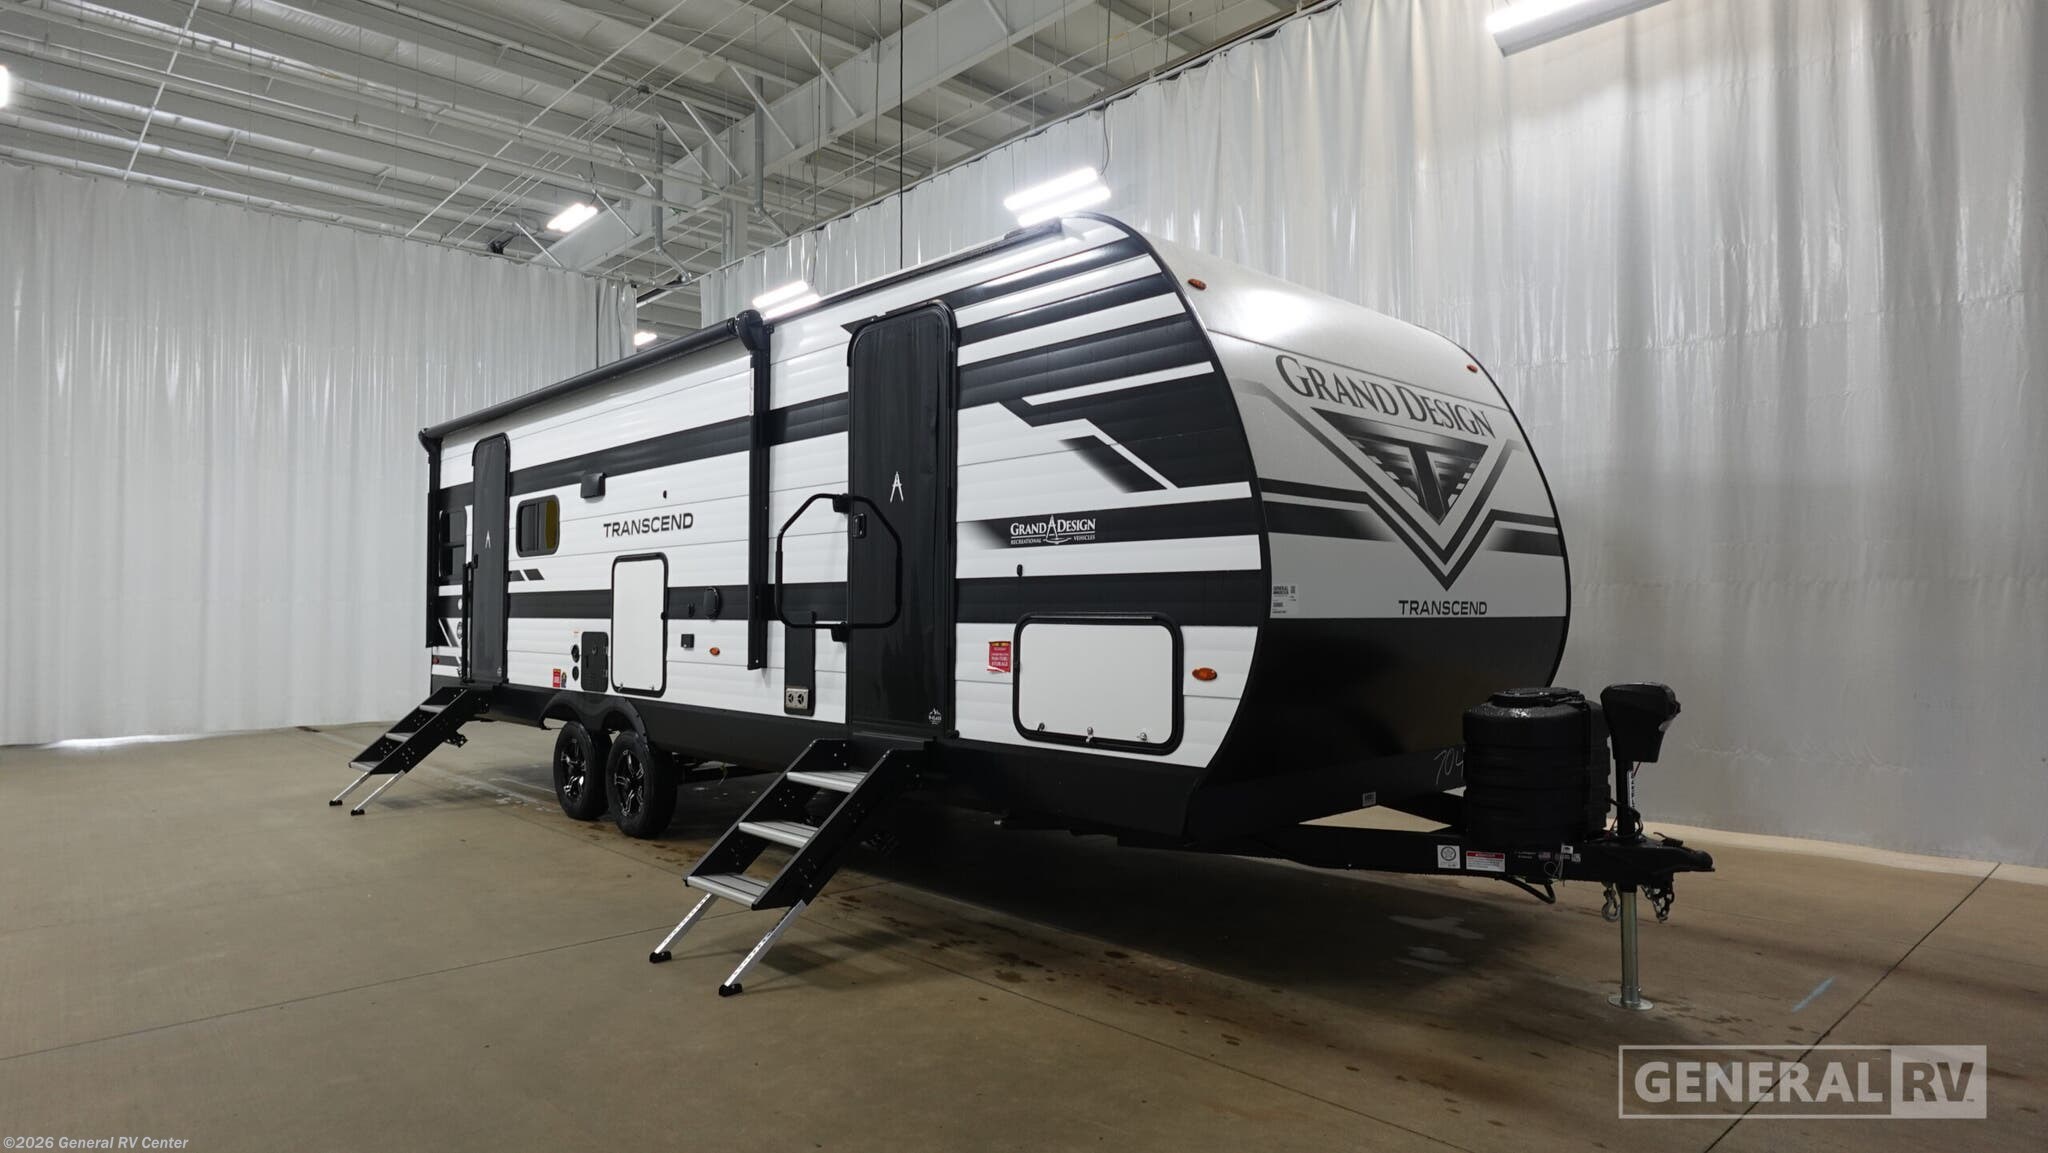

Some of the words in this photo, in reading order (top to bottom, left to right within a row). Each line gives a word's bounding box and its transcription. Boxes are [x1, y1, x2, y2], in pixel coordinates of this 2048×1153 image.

[1276, 354, 1400, 416] GRAND
[1395, 384, 1496, 439] DESIGN
[603, 512, 694, 538] TRANSCEND
[1010, 522, 1047, 536] GRAND
[1057, 518, 1096, 533] DESIGN
[1398, 600, 1488, 616] TRANSCEND
